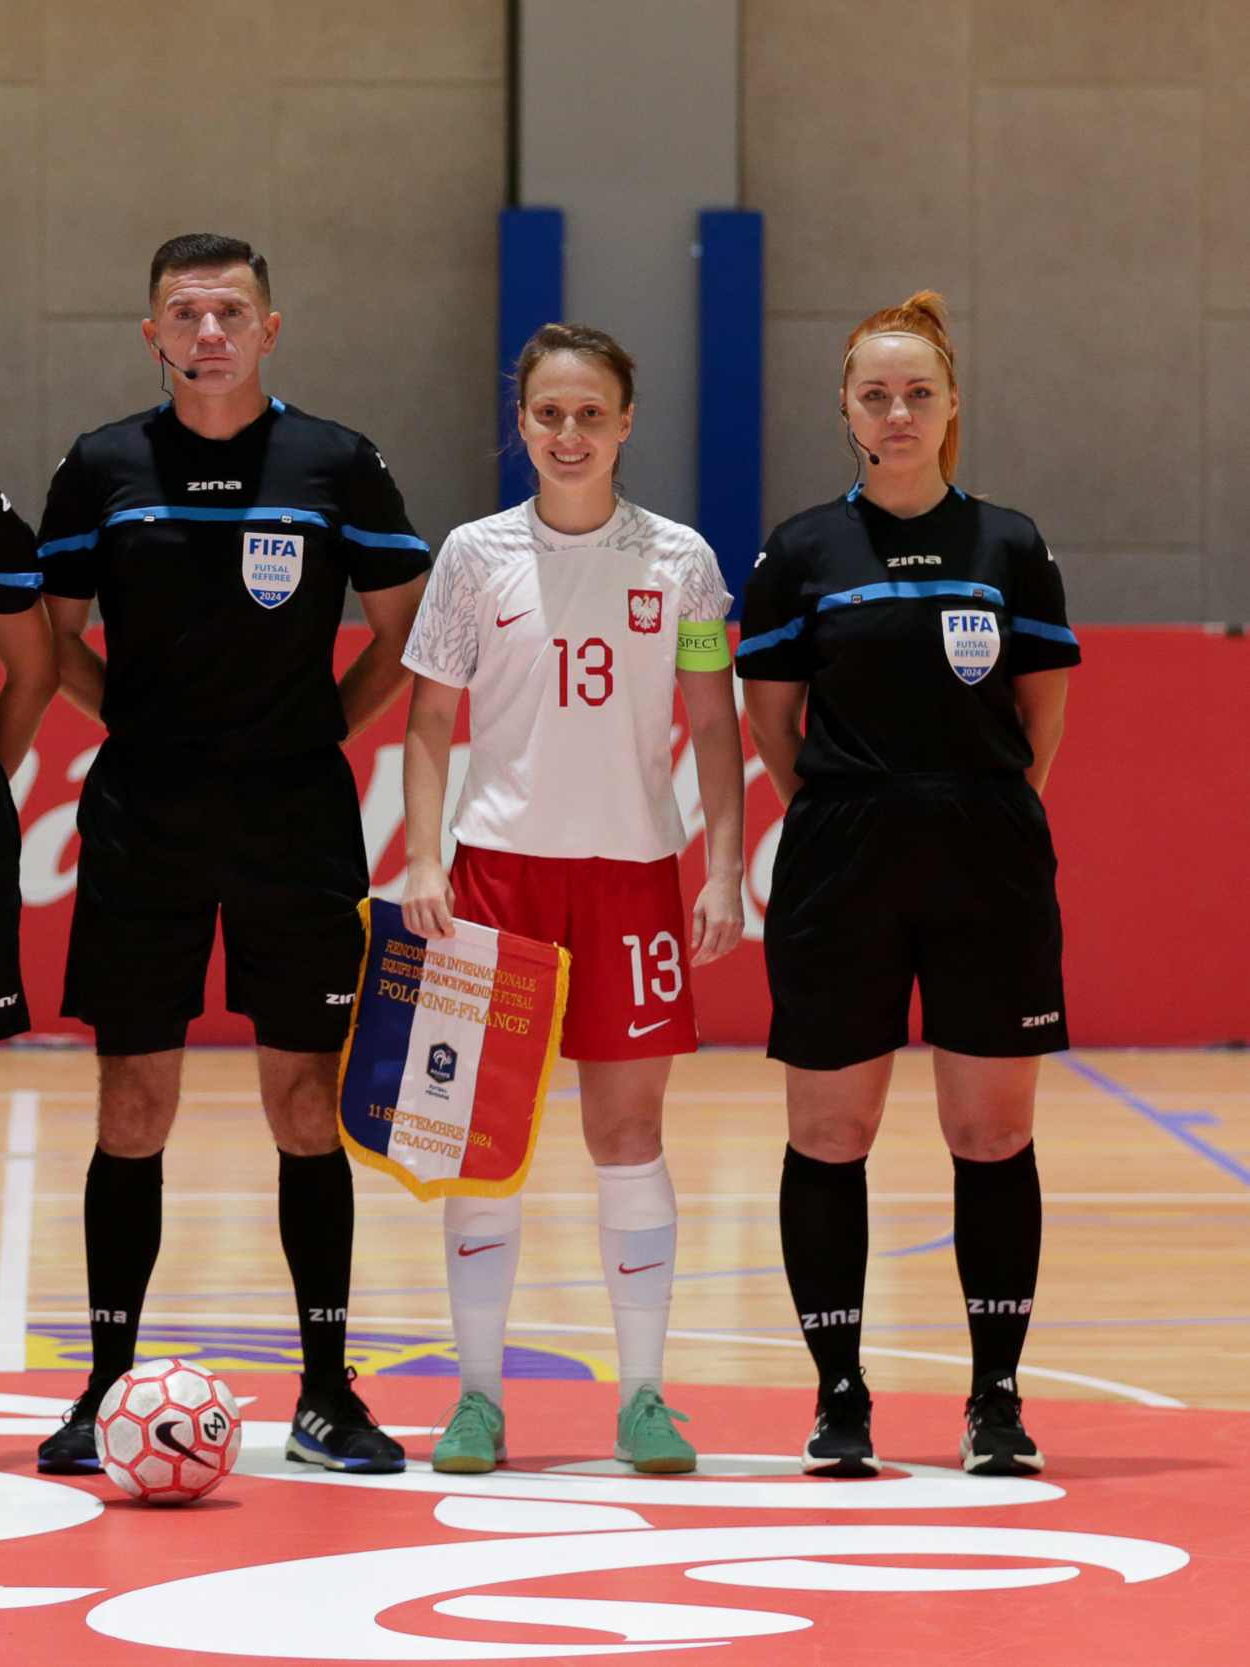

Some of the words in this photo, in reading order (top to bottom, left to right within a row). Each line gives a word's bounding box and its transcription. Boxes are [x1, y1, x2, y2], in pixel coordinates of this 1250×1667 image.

[187, 480, 242, 491] zina
[249, 538, 297, 557] FIFA
[254, 563, 289, 573] FUTSAL
[886, 555, 942, 568] zina
[251, 572, 292, 582] REFEREE
[259, 591, 282, 601] 2024
[948, 615, 994, 632] FIFA
[677, 636, 718, 649] SPECT
[956, 640, 989, 649] FUTSAL
[954, 649, 991, 657] REFEREE
[553, 637, 613, 707] 13
[962, 667, 982, 677] 2024
[384, 939, 446, 968] RENCONTRE
[447, 956, 537, 993] INTERNATIONALE
[622, 931, 683, 1007] 13
[381, 957, 412, 978] EQUIPE
[412, 965, 425, 982] DE
[425, 970, 457, 991] FRANCE
[457, 978, 500, 1002] FEMININE
[500, 990, 534, 1011] FUTSAL
[325, 993, 356, 1005] zin
[377, 979, 531, 1036] POLOGNE-FRANCE
[1021, 1011, 1059, 1028] zina
[368, 1103, 381, 1119] 11
[383, 1106, 466, 1141] SEPTEMBRE
[467, 1130, 493, 1149] 2024
[393, 1129, 462, 1160] CRACOVIE
[309, 1307, 347, 1322] zin
[967, 1298, 1033, 1315] zina
[90, 1308, 127, 1324] ina
[801, 1308, 861, 1330] zina
